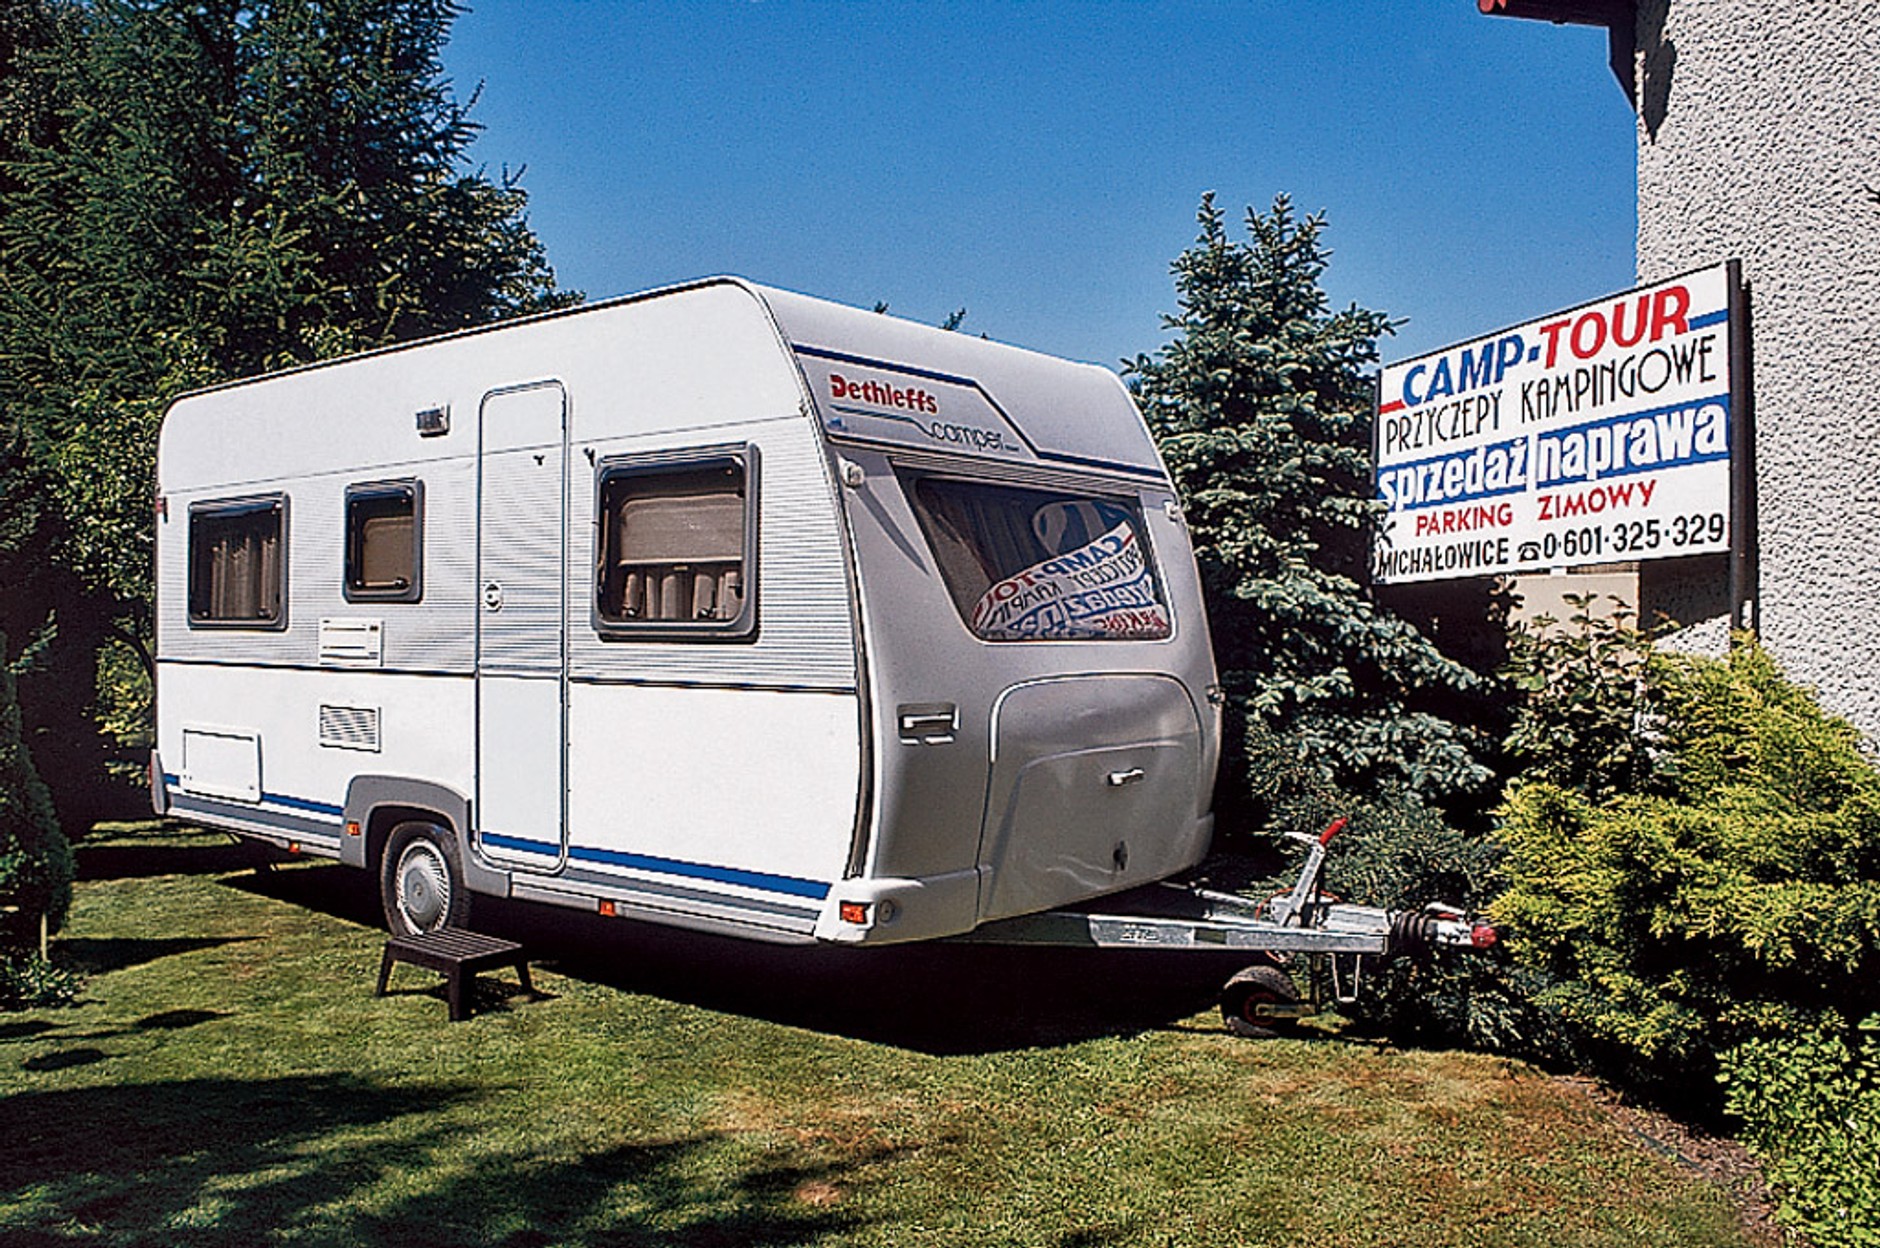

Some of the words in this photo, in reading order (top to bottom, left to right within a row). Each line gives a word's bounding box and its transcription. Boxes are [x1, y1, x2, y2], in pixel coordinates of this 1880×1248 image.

[1403, 285, 1690, 406] CAMP-TOUR
[830, 374, 938, 415] Dethleffs
[1386, 389, 1503, 455] PRZYCZEPY
[1521, 334, 1716, 423] KAMPINGOWE
[931, 421, 1006, 452] camper
[1378, 436, 1528, 512] sprzedaż
[1536, 402, 1728, 483] naprawa
[1415, 503, 1513, 537] PARKING
[1538, 480, 1656, 521] ZIMOWY
[1377, 537, 1509, 577] MICHAŁOWICE
